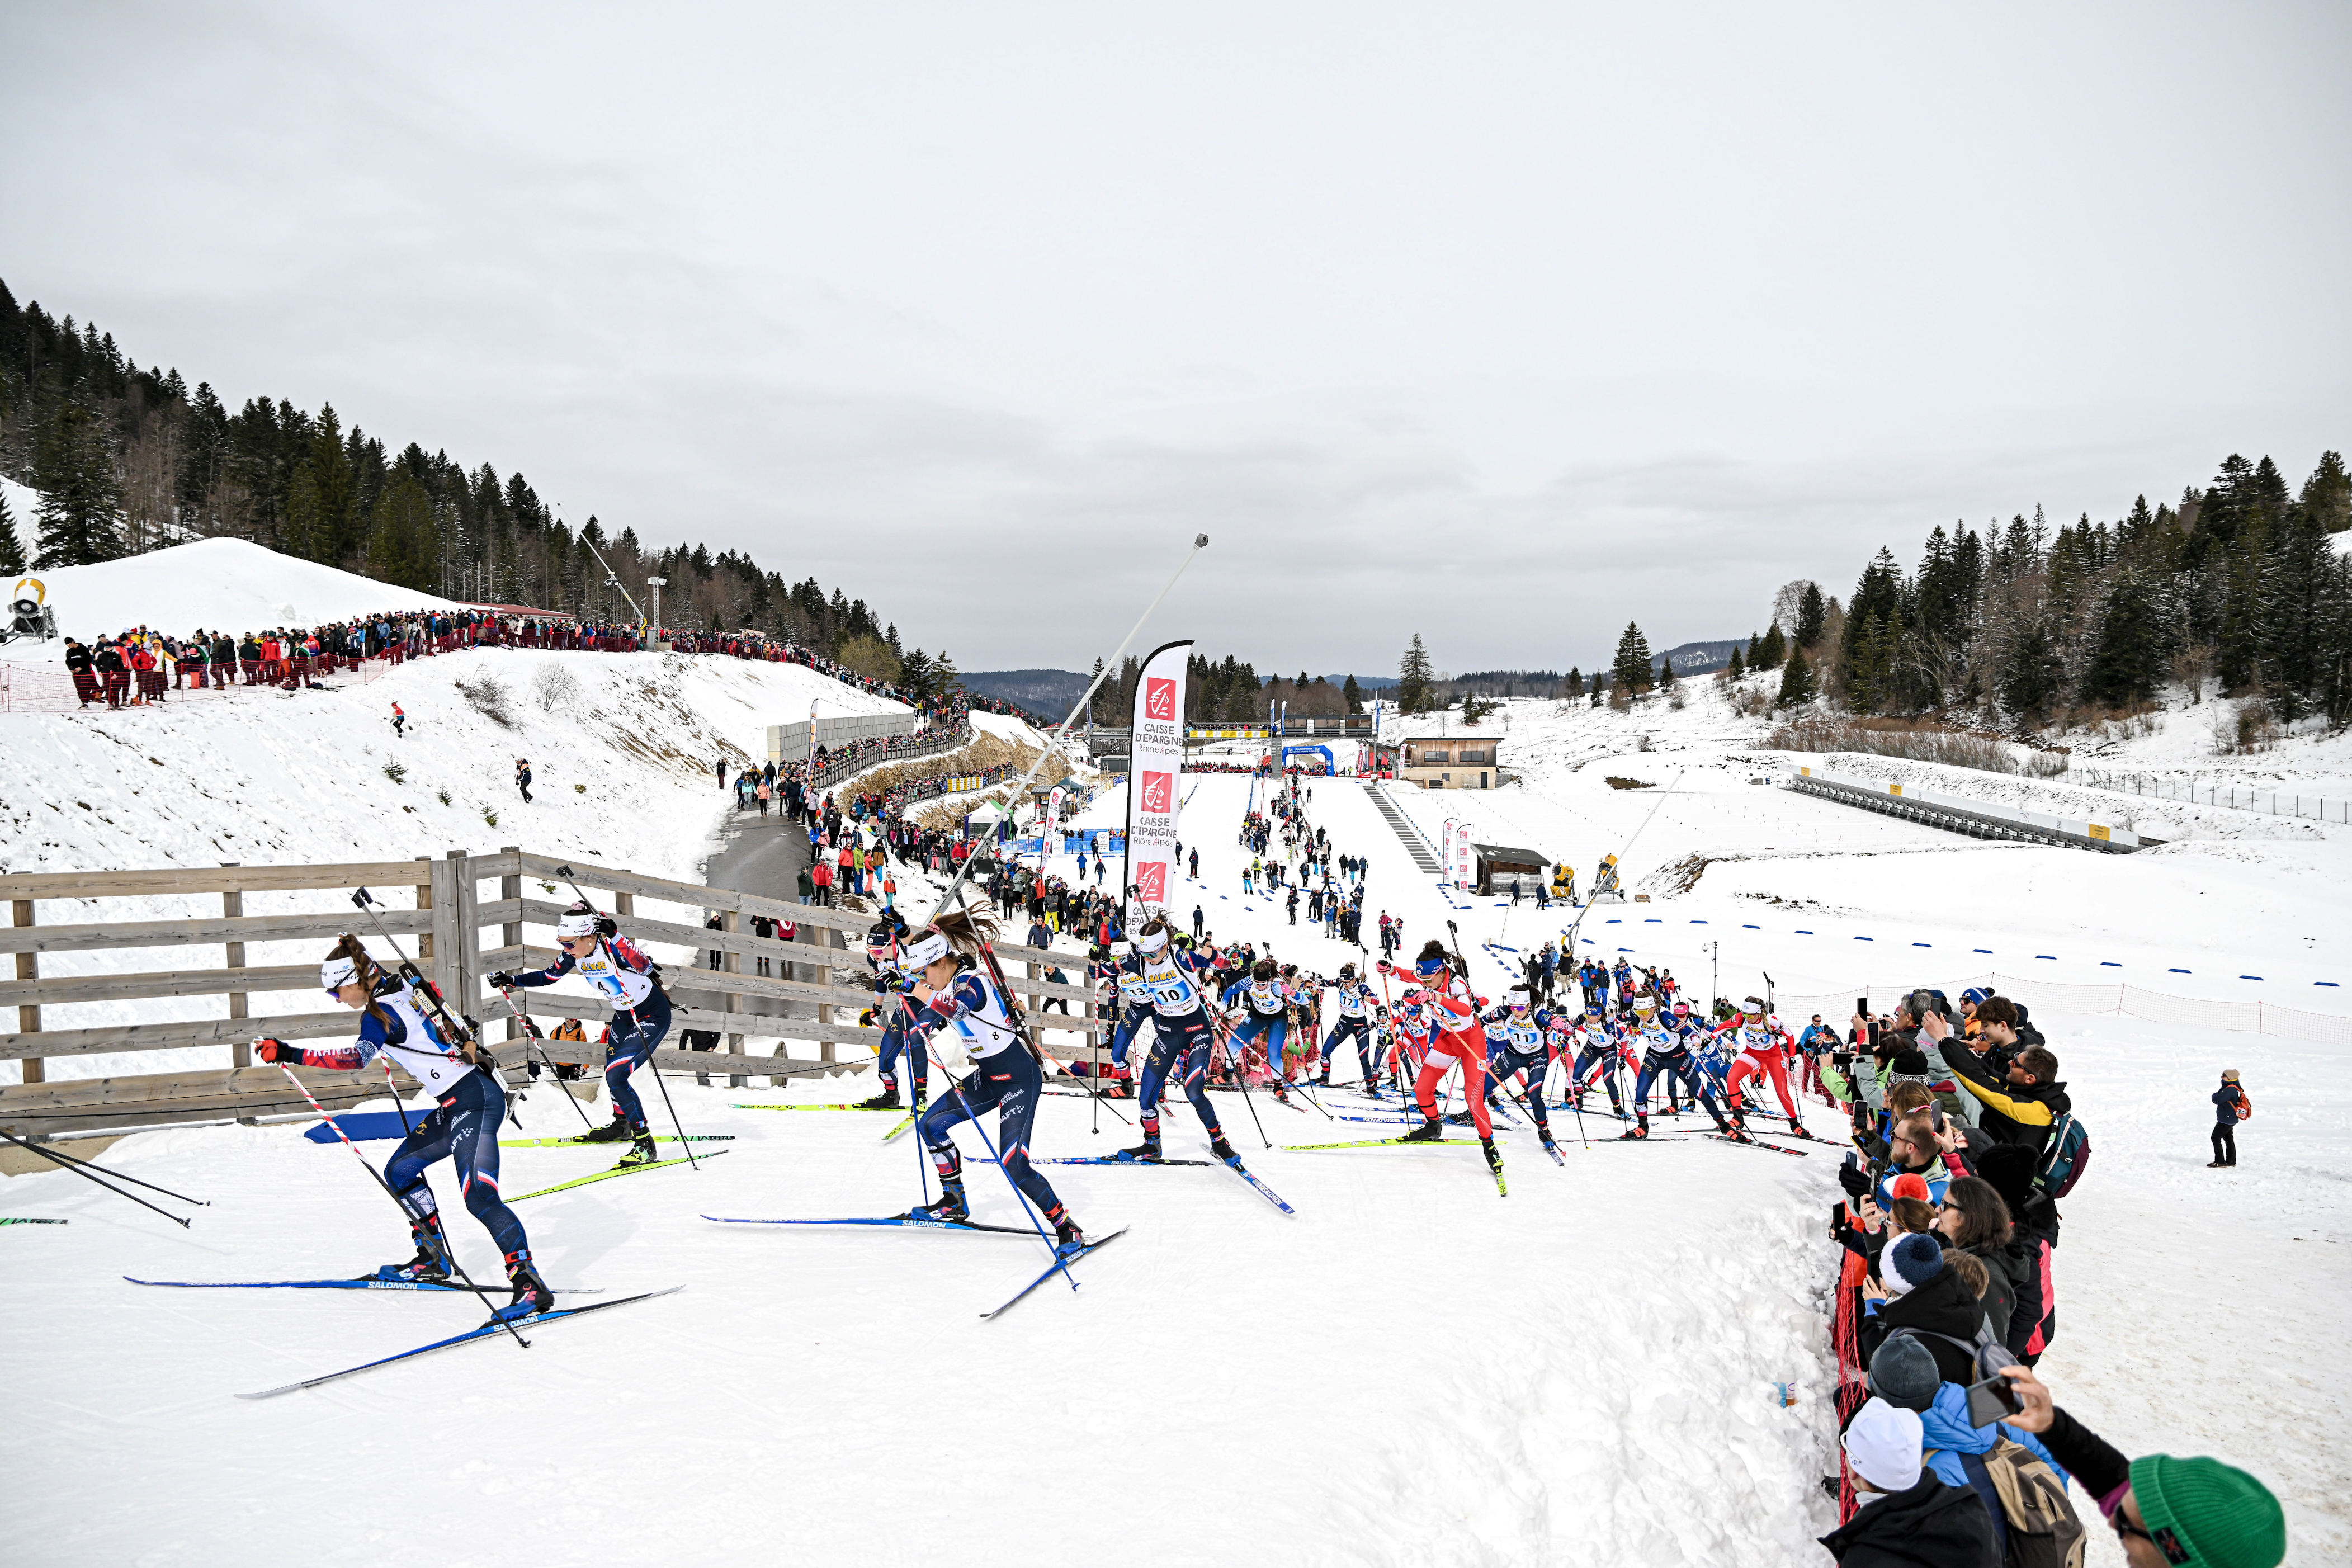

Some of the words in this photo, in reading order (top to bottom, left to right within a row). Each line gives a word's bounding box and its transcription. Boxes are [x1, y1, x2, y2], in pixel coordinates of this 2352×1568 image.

[1144, 723, 1175, 735] CAISSE
[1135, 733, 1182, 747] D'EPARGNE
[1160, 746, 1179, 756] Alpes
[1153, 838, 1173, 847] Alpes
[581, 961, 607, 972] SAMSE
[1149, 970, 1177, 984] SAMSE
[598, 981, 610, 994] 4
[1129, 988, 1145, 996] 13
[1158, 990, 1180, 1003] 10
[1343, 996, 1353, 1006] 17
[418, 994, 435, 1013] LARSEN
[1510, 1018, 1533, 1028] SAMSE
[992, 1031, 999, 1040] 8
[1514, 1033, 1528, 1042] 11
[430, 1069, 441, 1079] 6
[1529, 1064, 1544, 1073] CRAFT
[1000, 1091, 1013, 1103] CAISSE
[1001, 1088, 1025, 1106] D'EPARGNE
[451, 1133, 464, 1153] AFT
[1263, 1187, 1283, 1205] SALOMON
[1065, 1250, 1084, 1264] SALOMON
[367, 1282, 418, 1290] SALOMON
